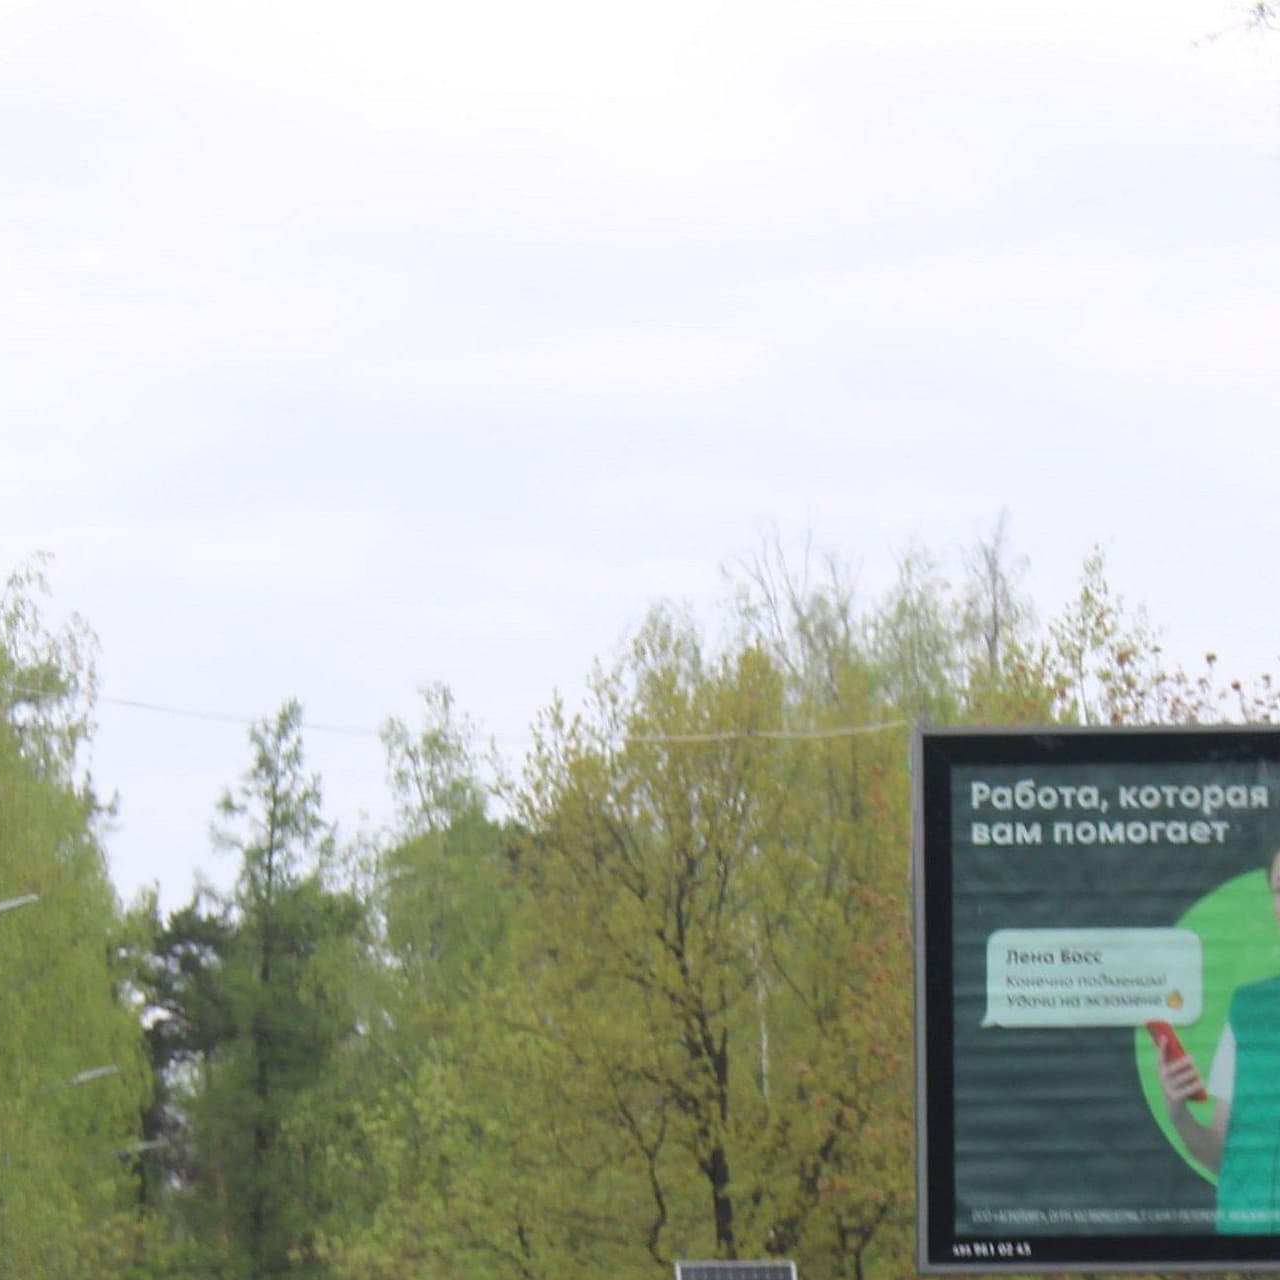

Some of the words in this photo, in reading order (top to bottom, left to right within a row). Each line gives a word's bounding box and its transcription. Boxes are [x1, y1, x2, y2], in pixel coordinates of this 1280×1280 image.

[970, 779, 1109, 814] Работа,
[1119, 784, 1269, 815] которая
[971, 820, 1043, 846] вам
[1053, 820, 1230, 846] помогает
